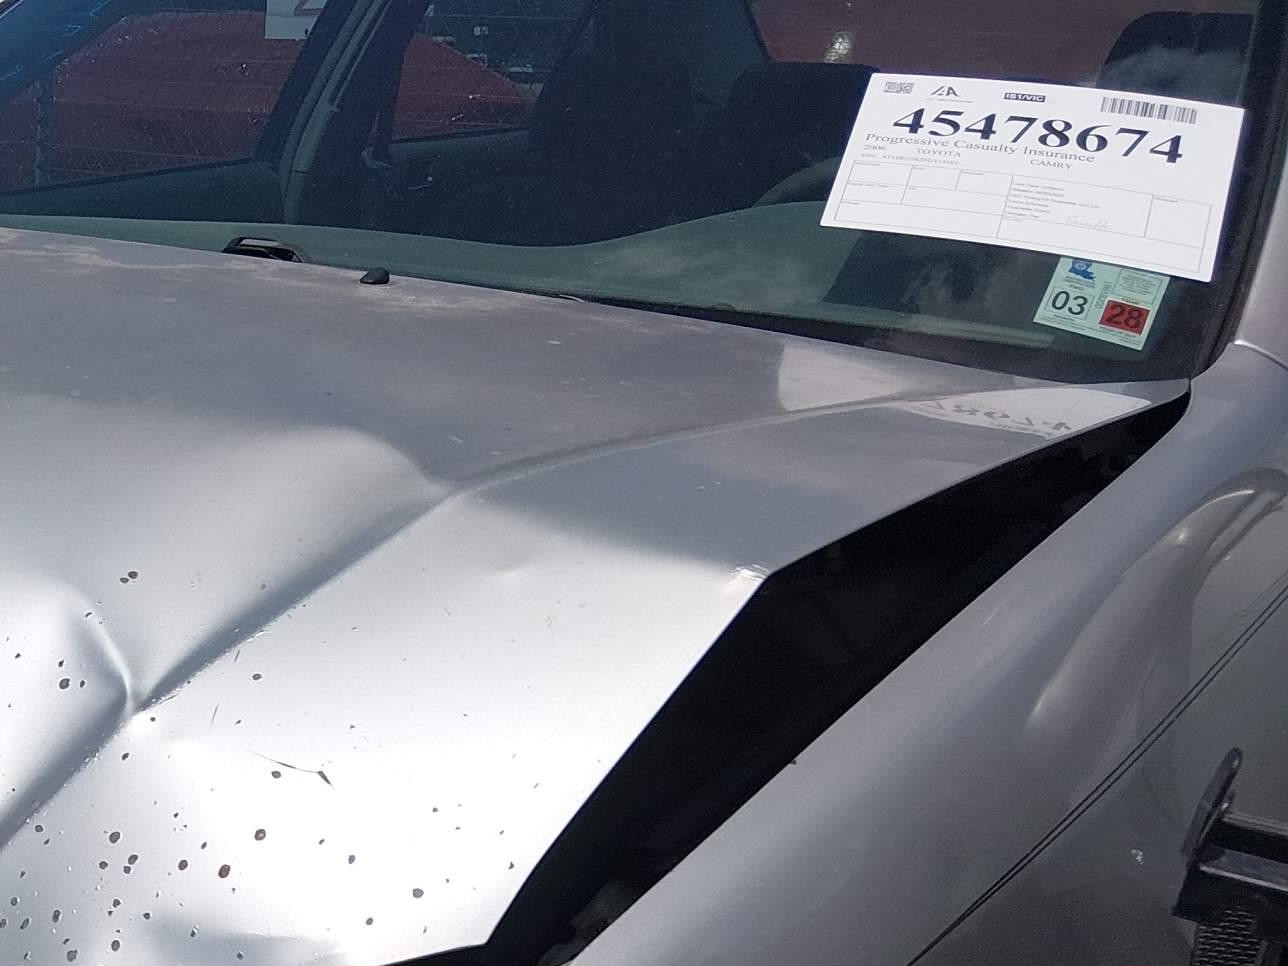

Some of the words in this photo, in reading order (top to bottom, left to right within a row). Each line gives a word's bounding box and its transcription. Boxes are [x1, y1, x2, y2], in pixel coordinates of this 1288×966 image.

[865, 133, 950, 148] Progressive
[954, 139, 1019, 155] Casualty
[1023, 146, 1096, 163] Insurance
[892, 107, 1183, 164] 45478674
[916, 148, 962, 158] TOYOTA
[1029, 159, 1073, 169] CAMRY
[1051, 290, 1089, 316] 03
[1105, 303, 1143, 329] 28
